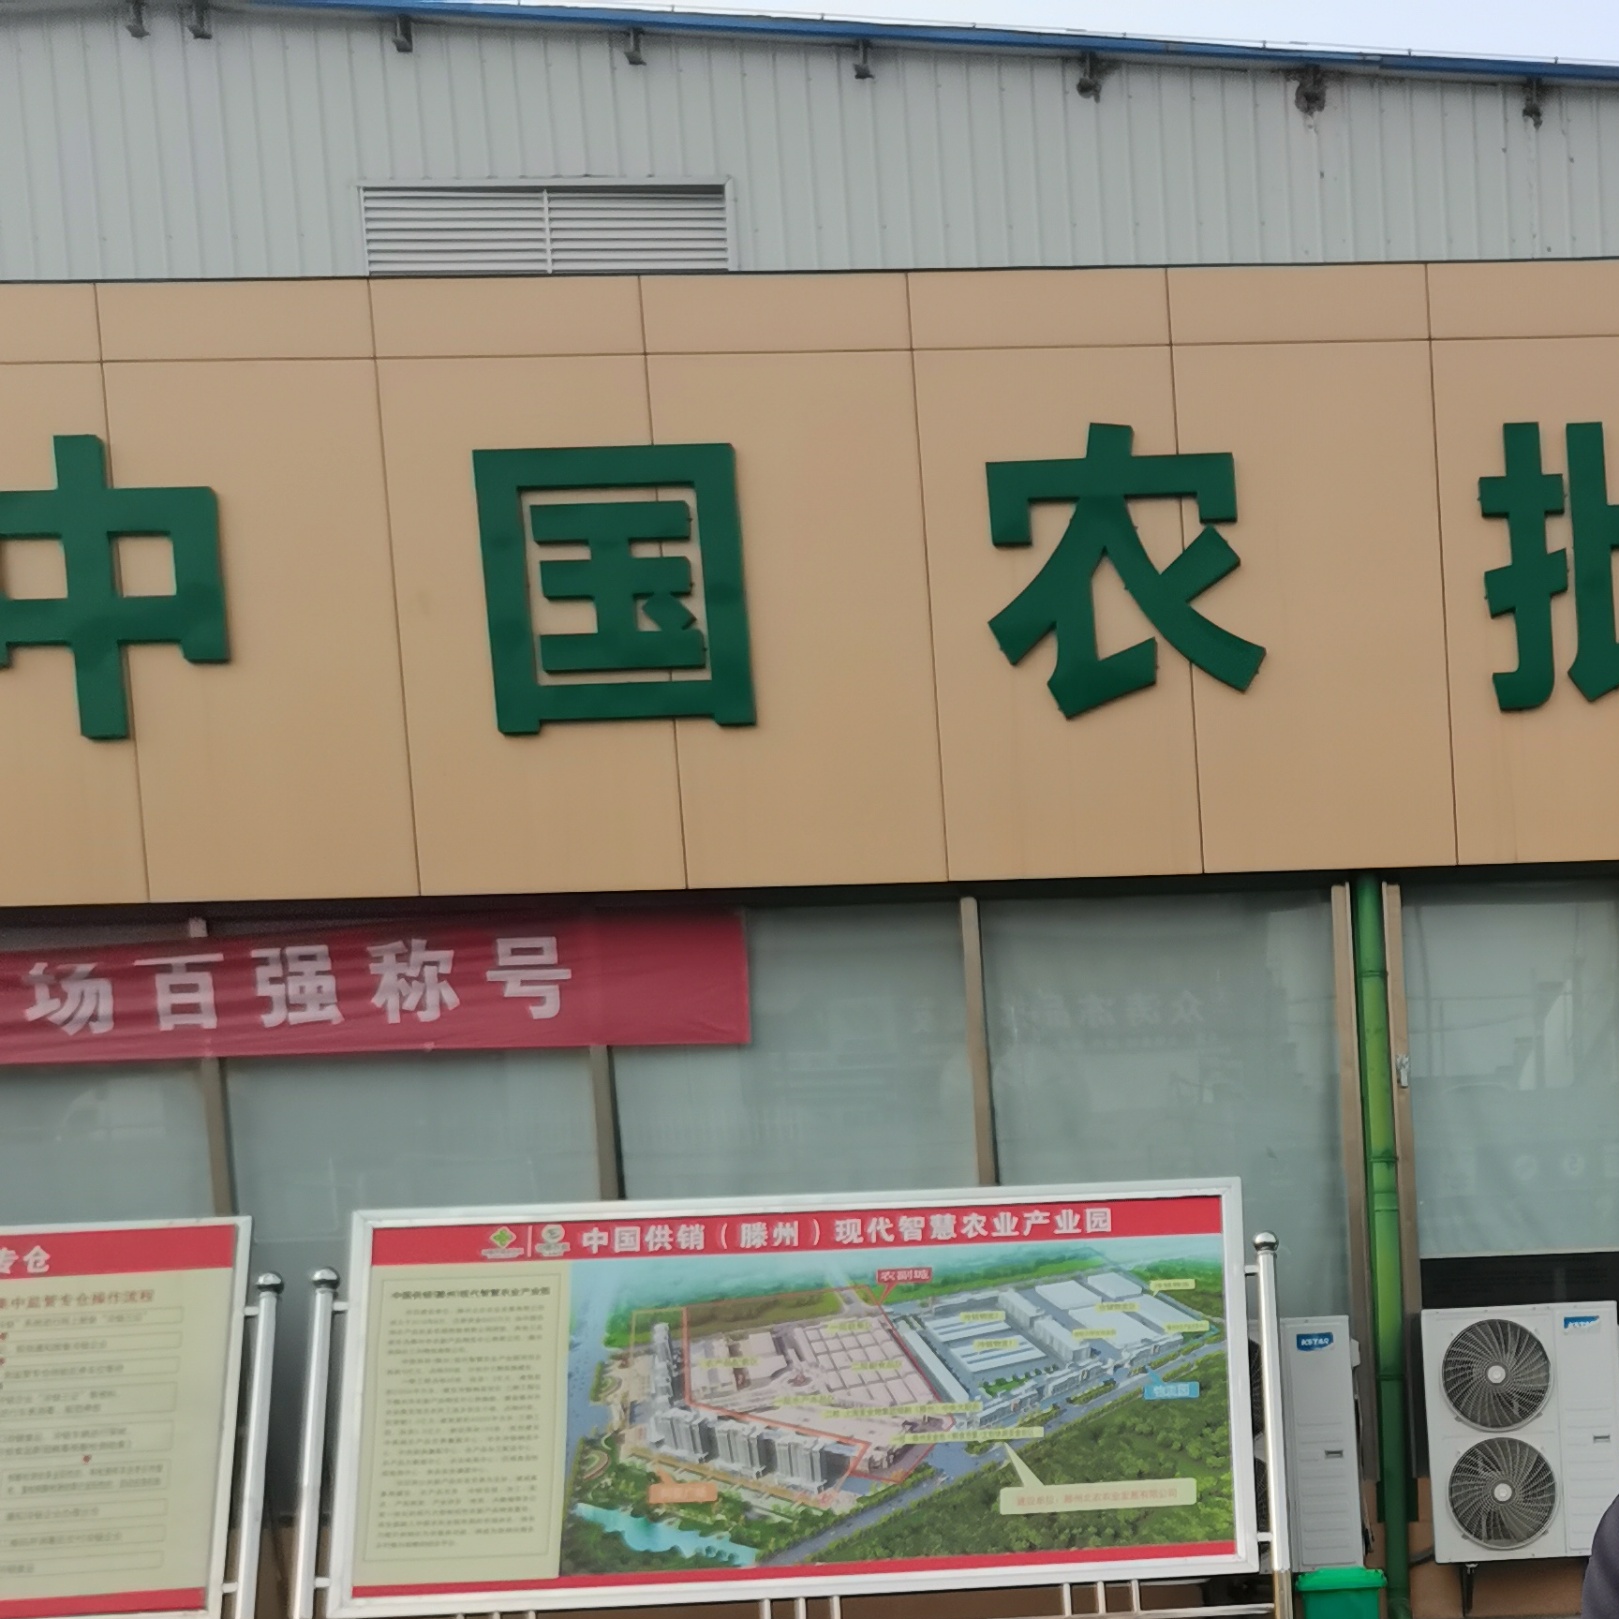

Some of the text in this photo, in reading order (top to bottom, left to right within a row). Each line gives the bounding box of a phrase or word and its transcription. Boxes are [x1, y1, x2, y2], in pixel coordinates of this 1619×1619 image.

[23, 936, 572, 1036] 场百强称号
[582, 1207, 1111, 1254] 中国供销（滕州）现代智慧农业产业园
